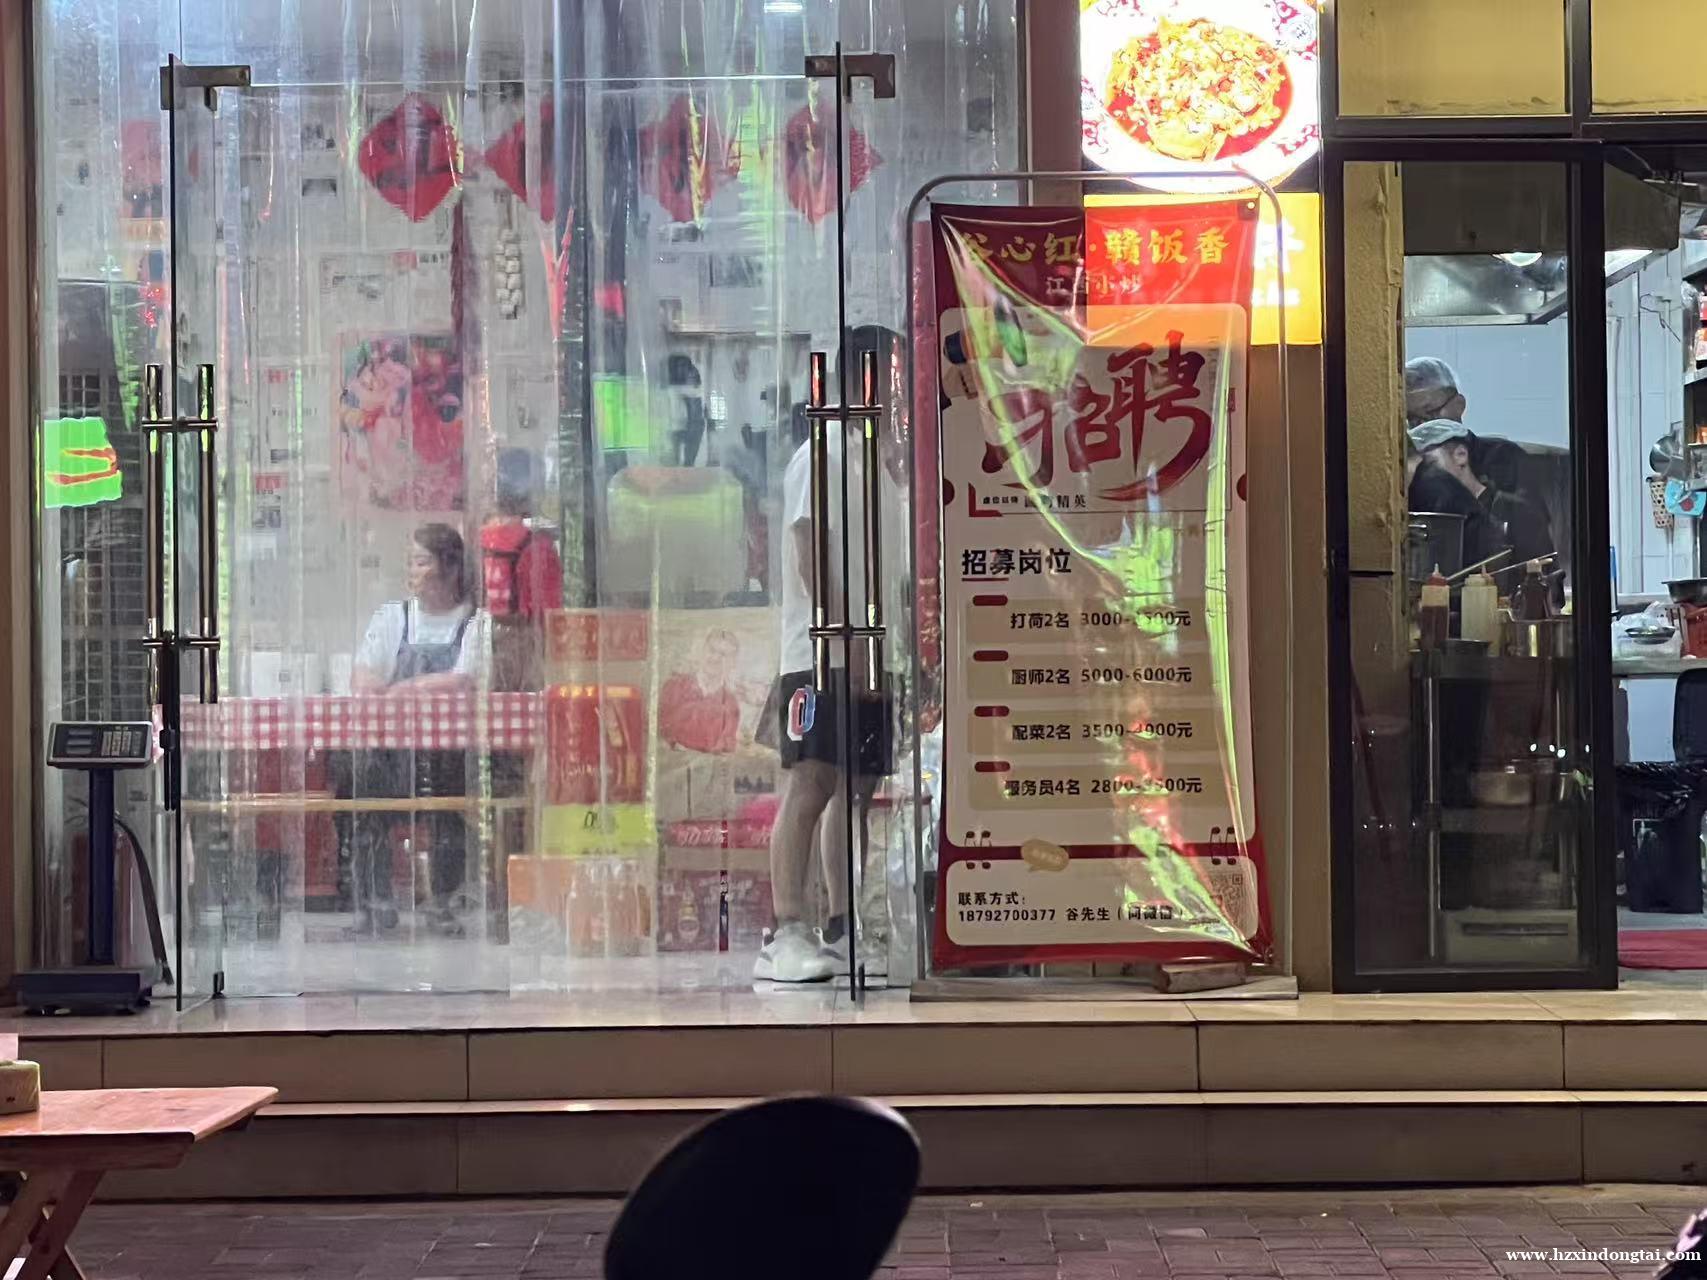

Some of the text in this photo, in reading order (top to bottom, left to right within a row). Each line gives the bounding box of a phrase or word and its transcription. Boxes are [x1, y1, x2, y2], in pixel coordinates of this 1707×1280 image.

[981, 329, 1214, 502] 招聘
[962, 548, 1072, 575] 招募岗位
[1010, 610, 1191, 629] 打荷2名 3000-500元
[1011, 666, 1192, 685] 厨师2名 5000-6000元
[1012, 723, 1071, 741] 配菜2名
[1004, 778, 1081, 796] 服务员4名
[959, 908, 1056, 922] 18792700377
